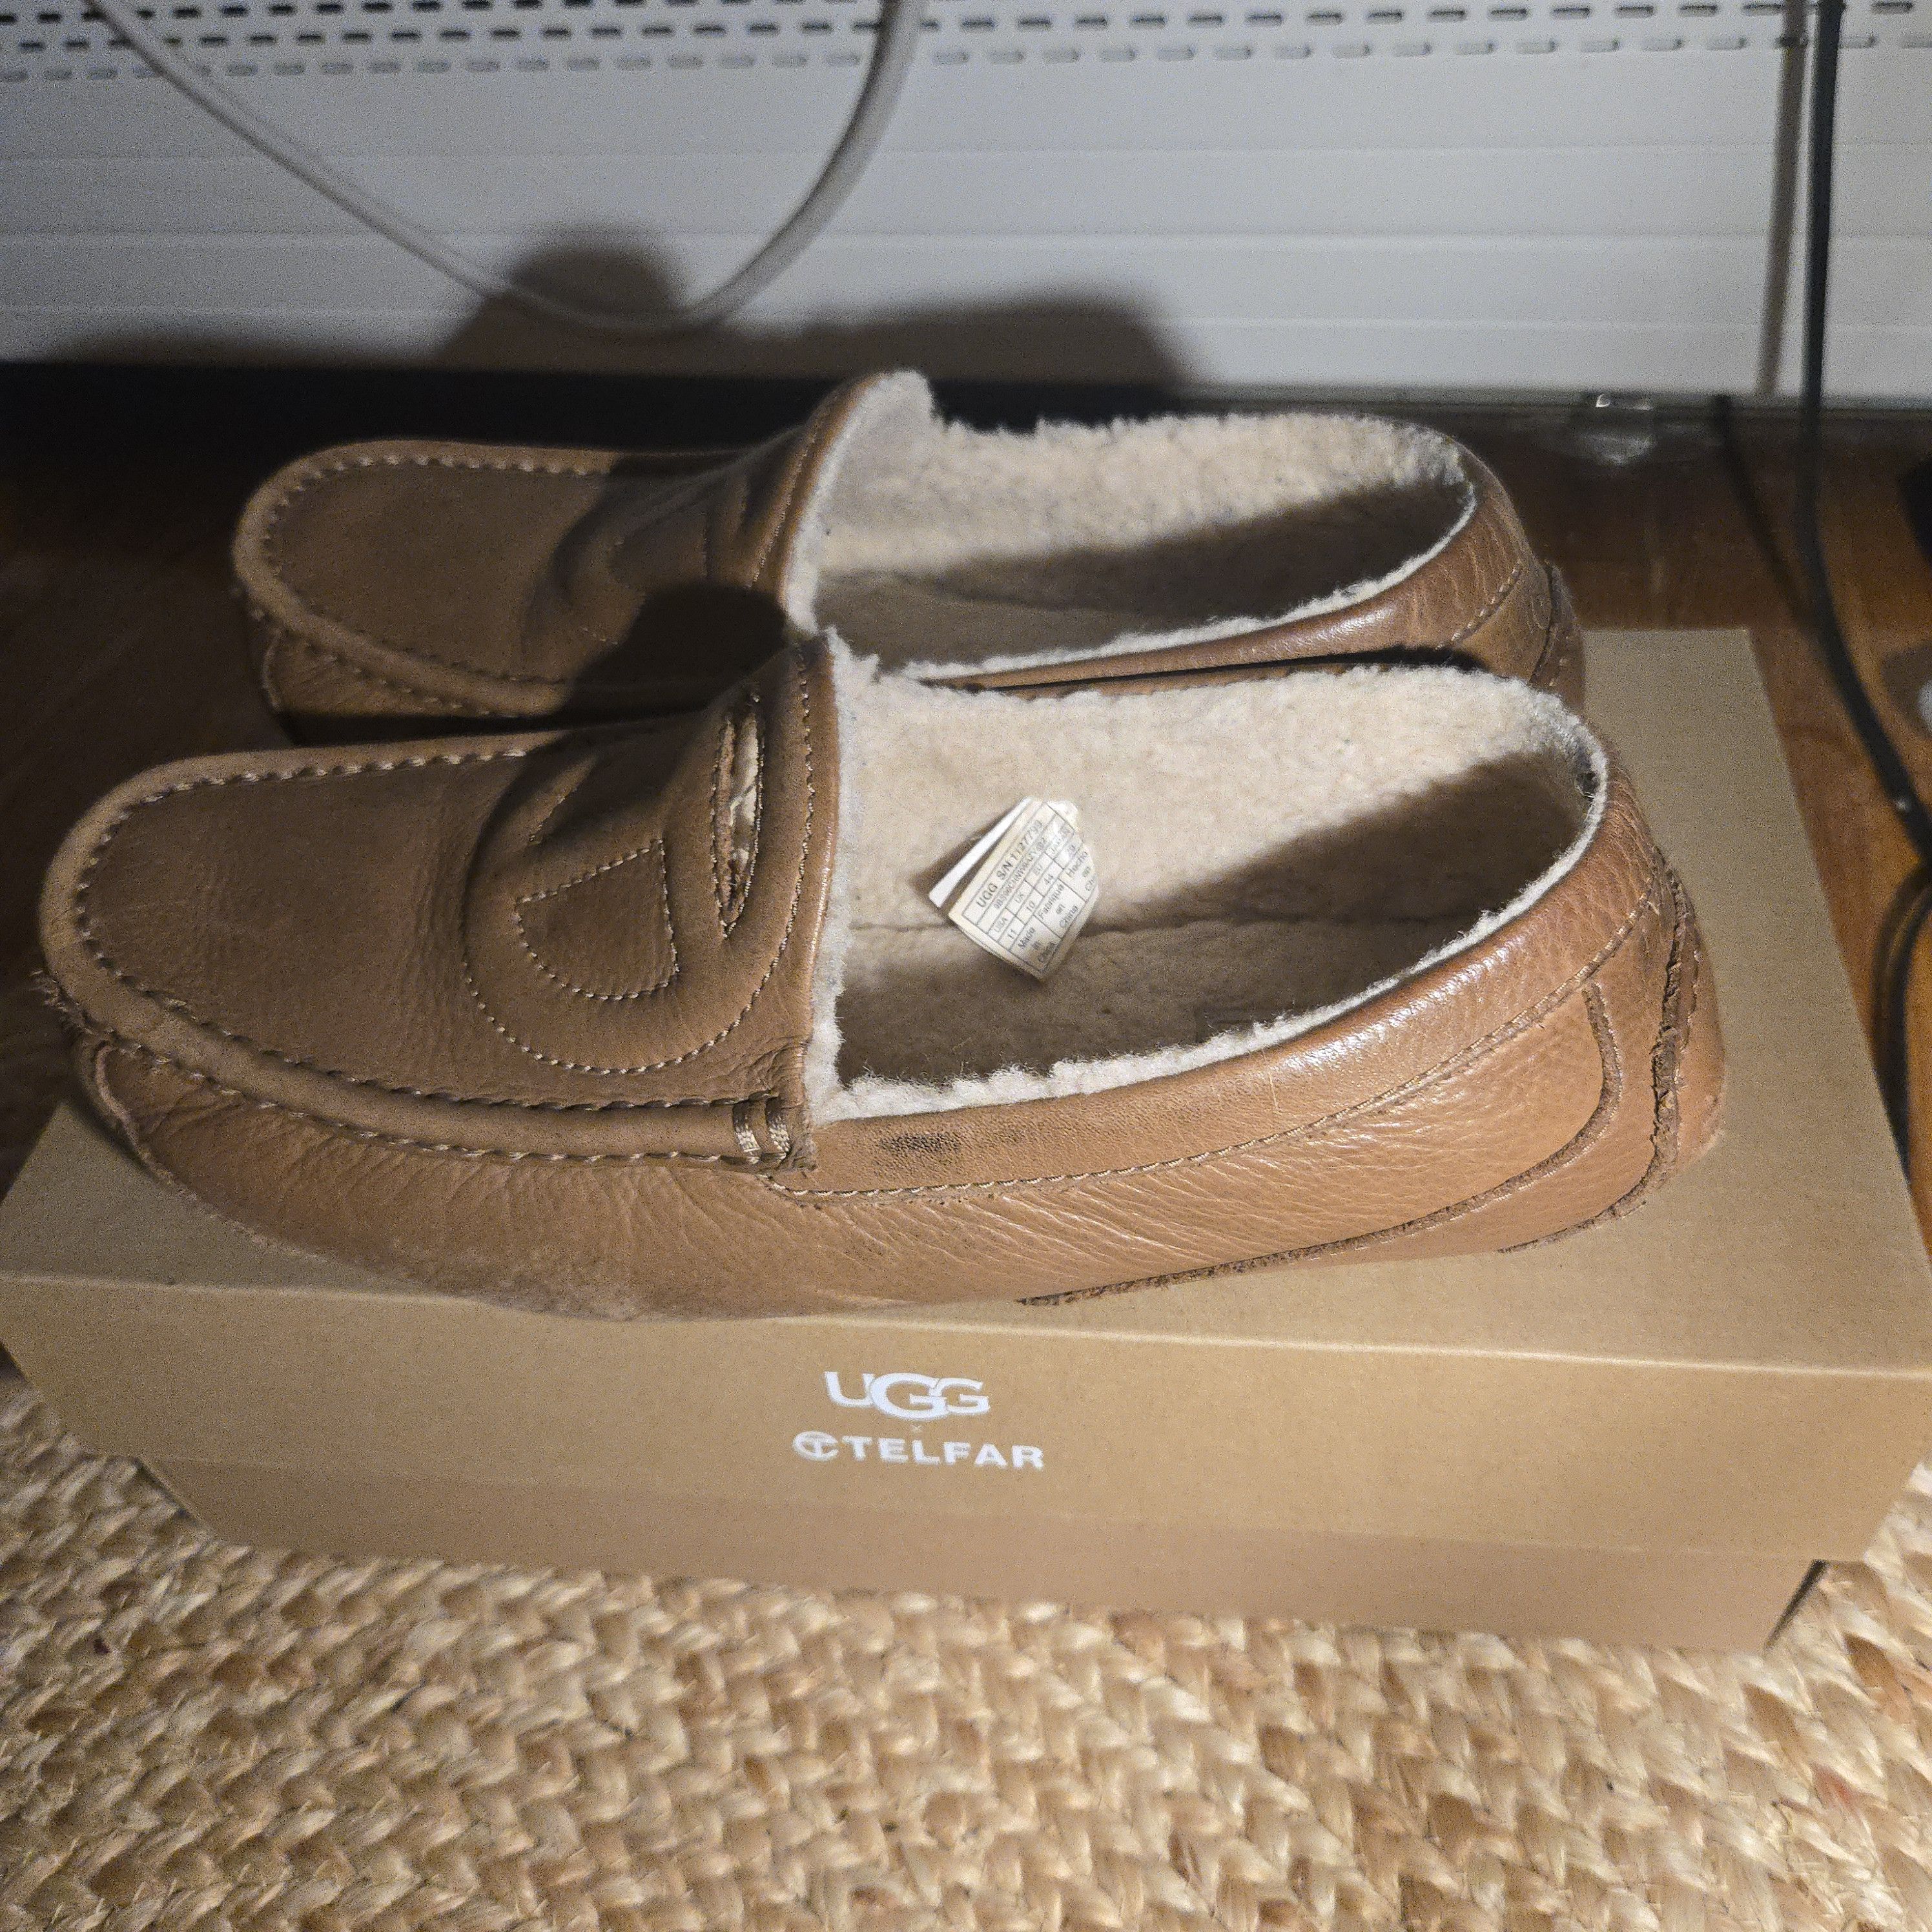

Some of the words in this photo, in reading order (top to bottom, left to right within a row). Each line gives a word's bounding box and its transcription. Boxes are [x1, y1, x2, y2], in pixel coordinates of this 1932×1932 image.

[976, 883, 998, 907] UGG
[996, 861, 1012, 879] S/N
[1015, 892, 1024, 903] UK
[1007, 929, 1016, 938] 11
[1026, 901, 1035, 911] 10
[1044, 874, 1053, 885] 44
[1018, 927, 1035, 949] Made
[824, 1371, 991, 1420] UGG
[842, 1436, 1043, 1470] TELFAR
